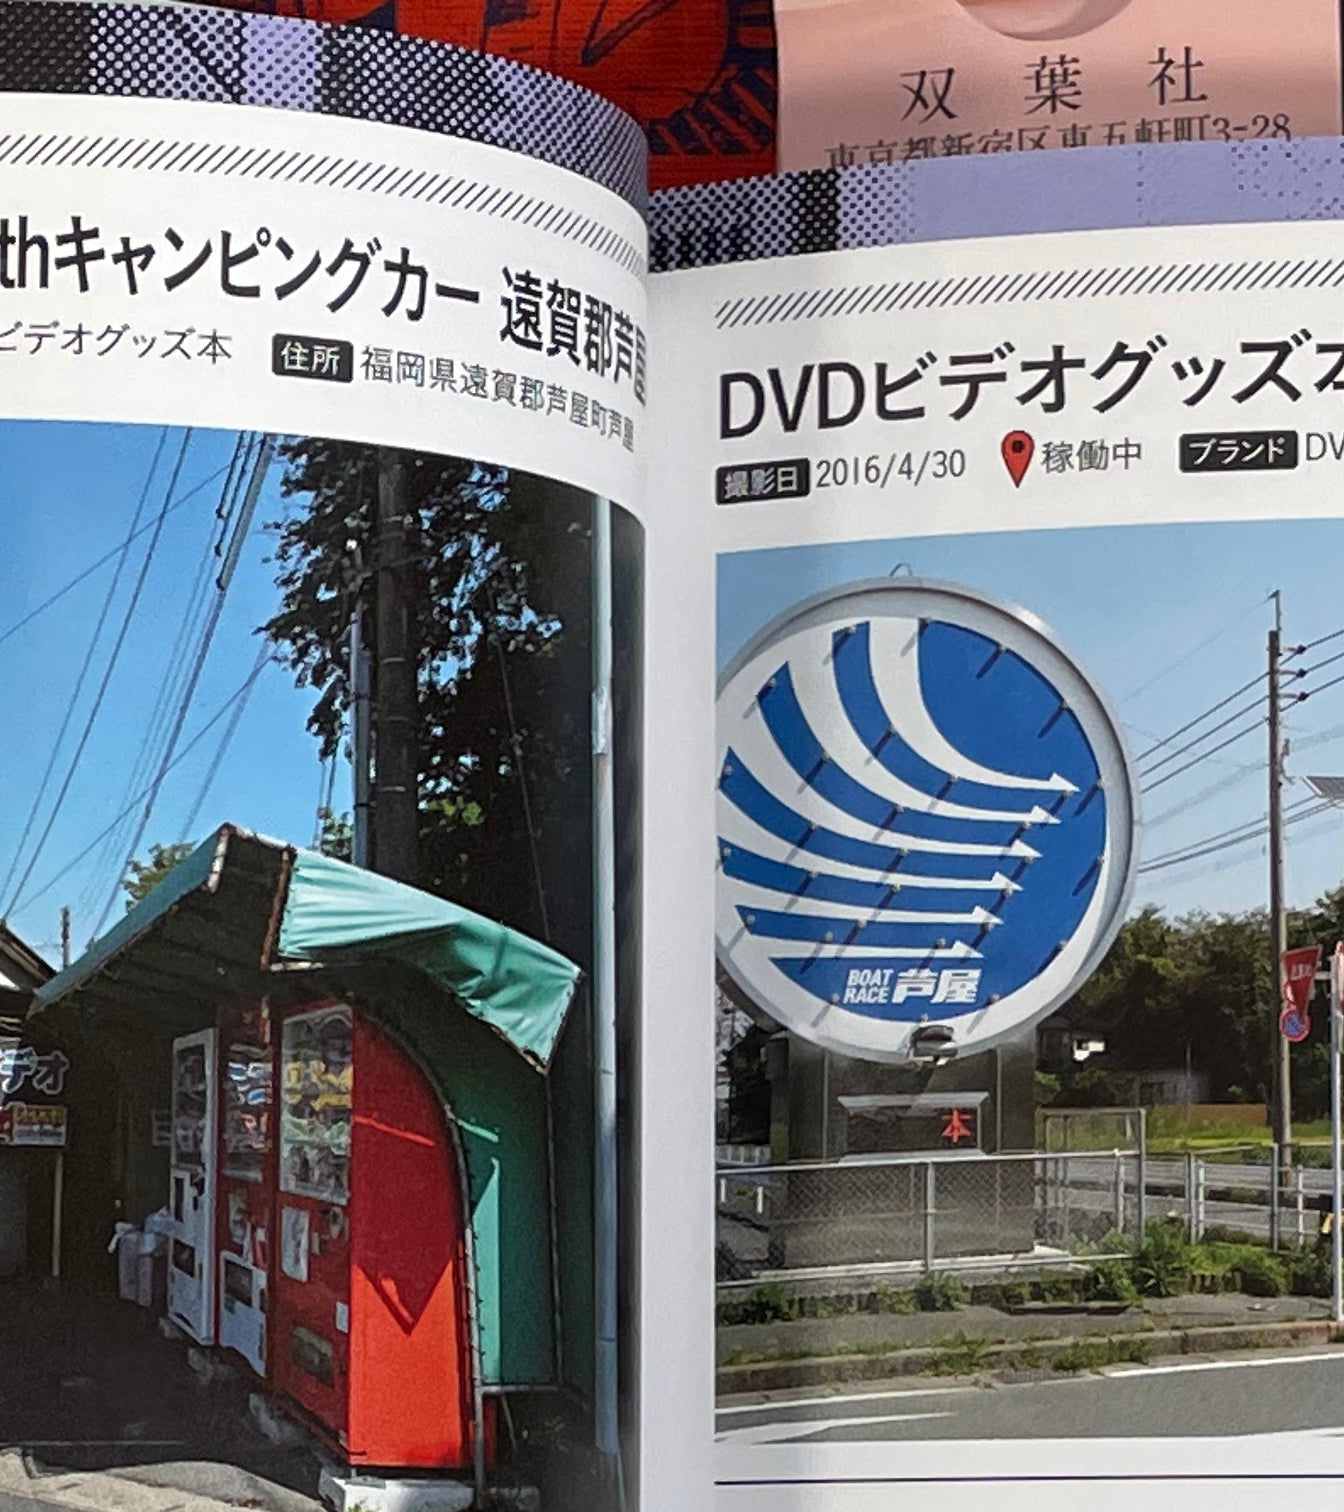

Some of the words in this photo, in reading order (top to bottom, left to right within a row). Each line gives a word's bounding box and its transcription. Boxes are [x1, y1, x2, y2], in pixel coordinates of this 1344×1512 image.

[899, 45, 1210, 122] 双葉社
[280, 340, 341, 376] 住所
[724, 469, 798, 500] 撮影日
[815, 449, 966, 489] 2016/4/30
[1041, 437, 1142, 473] 稼働中
[1189, 437, 1286, 463] ブランド
[842, 985, 890, 1004] RACE
[846, 968, 894, 986] BOAT
[892, 968, 982, 1004] 芦屋
